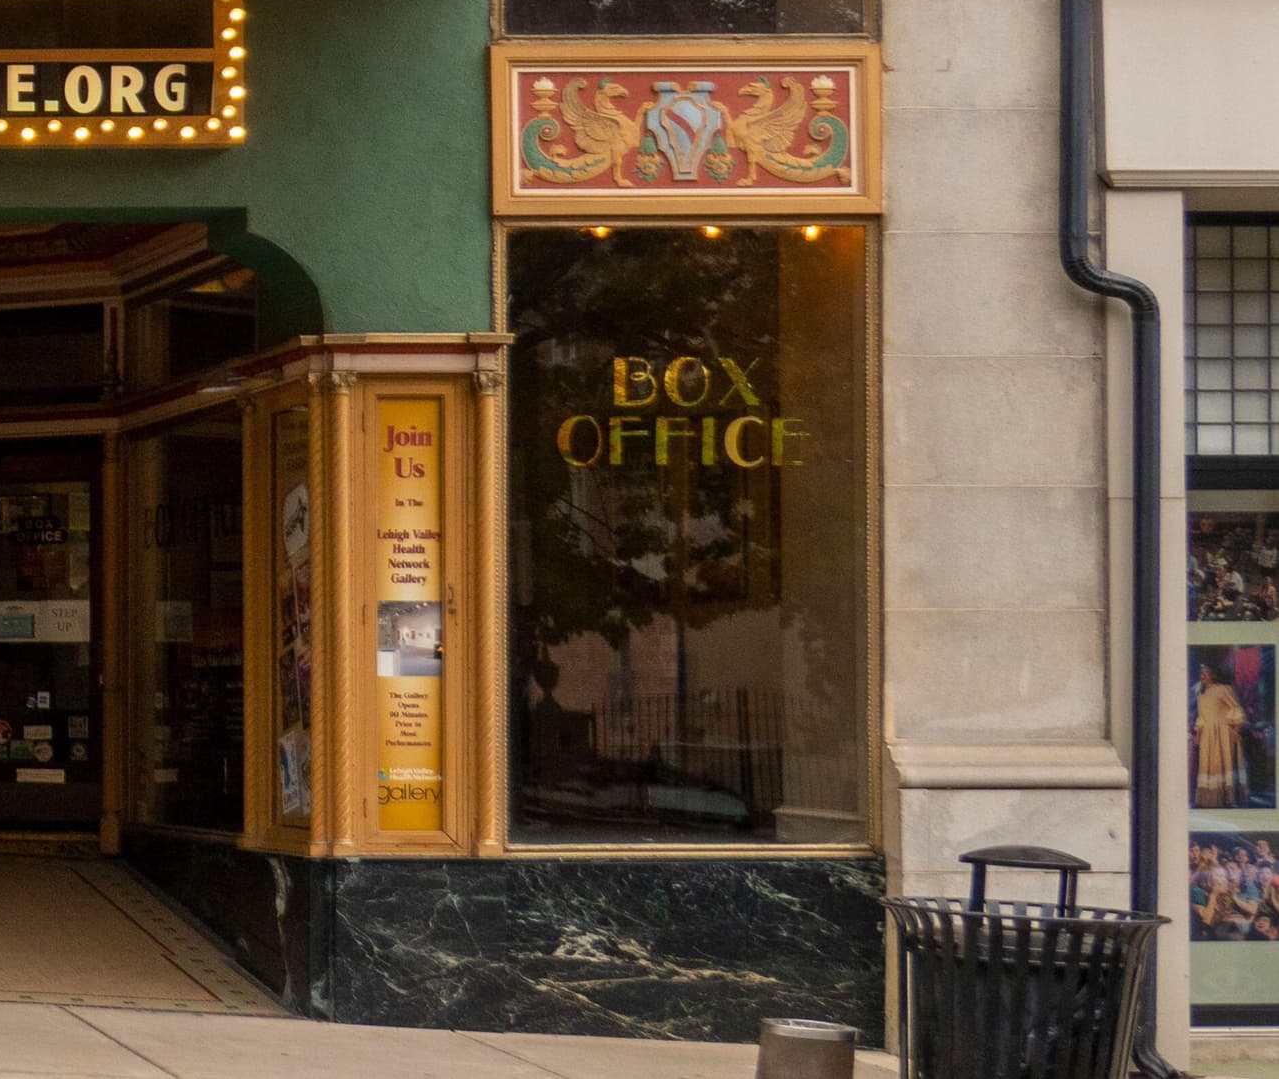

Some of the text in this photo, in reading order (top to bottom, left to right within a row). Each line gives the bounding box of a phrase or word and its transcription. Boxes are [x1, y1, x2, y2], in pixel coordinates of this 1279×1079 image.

[613, 356, 760, 407] BOX
[383, 425, 434, 453] Join
[556, 415, 811, 468] OFFICE
[394, 457, 426, 478] Us
[395, 498, 423, 507] In The
[377, 529, 442, 542] Lehigh Valley
[392, 544, 426, 554] Health
[388, 559, 430, 569] Network
[391, 574, 427, 586] Gallery
[52, 608, 78, 617] STEP
[57, 623, 73, 632] UP
[404, 692, 428, 700] Gallery
[378, 784, 442, 805] gallery
